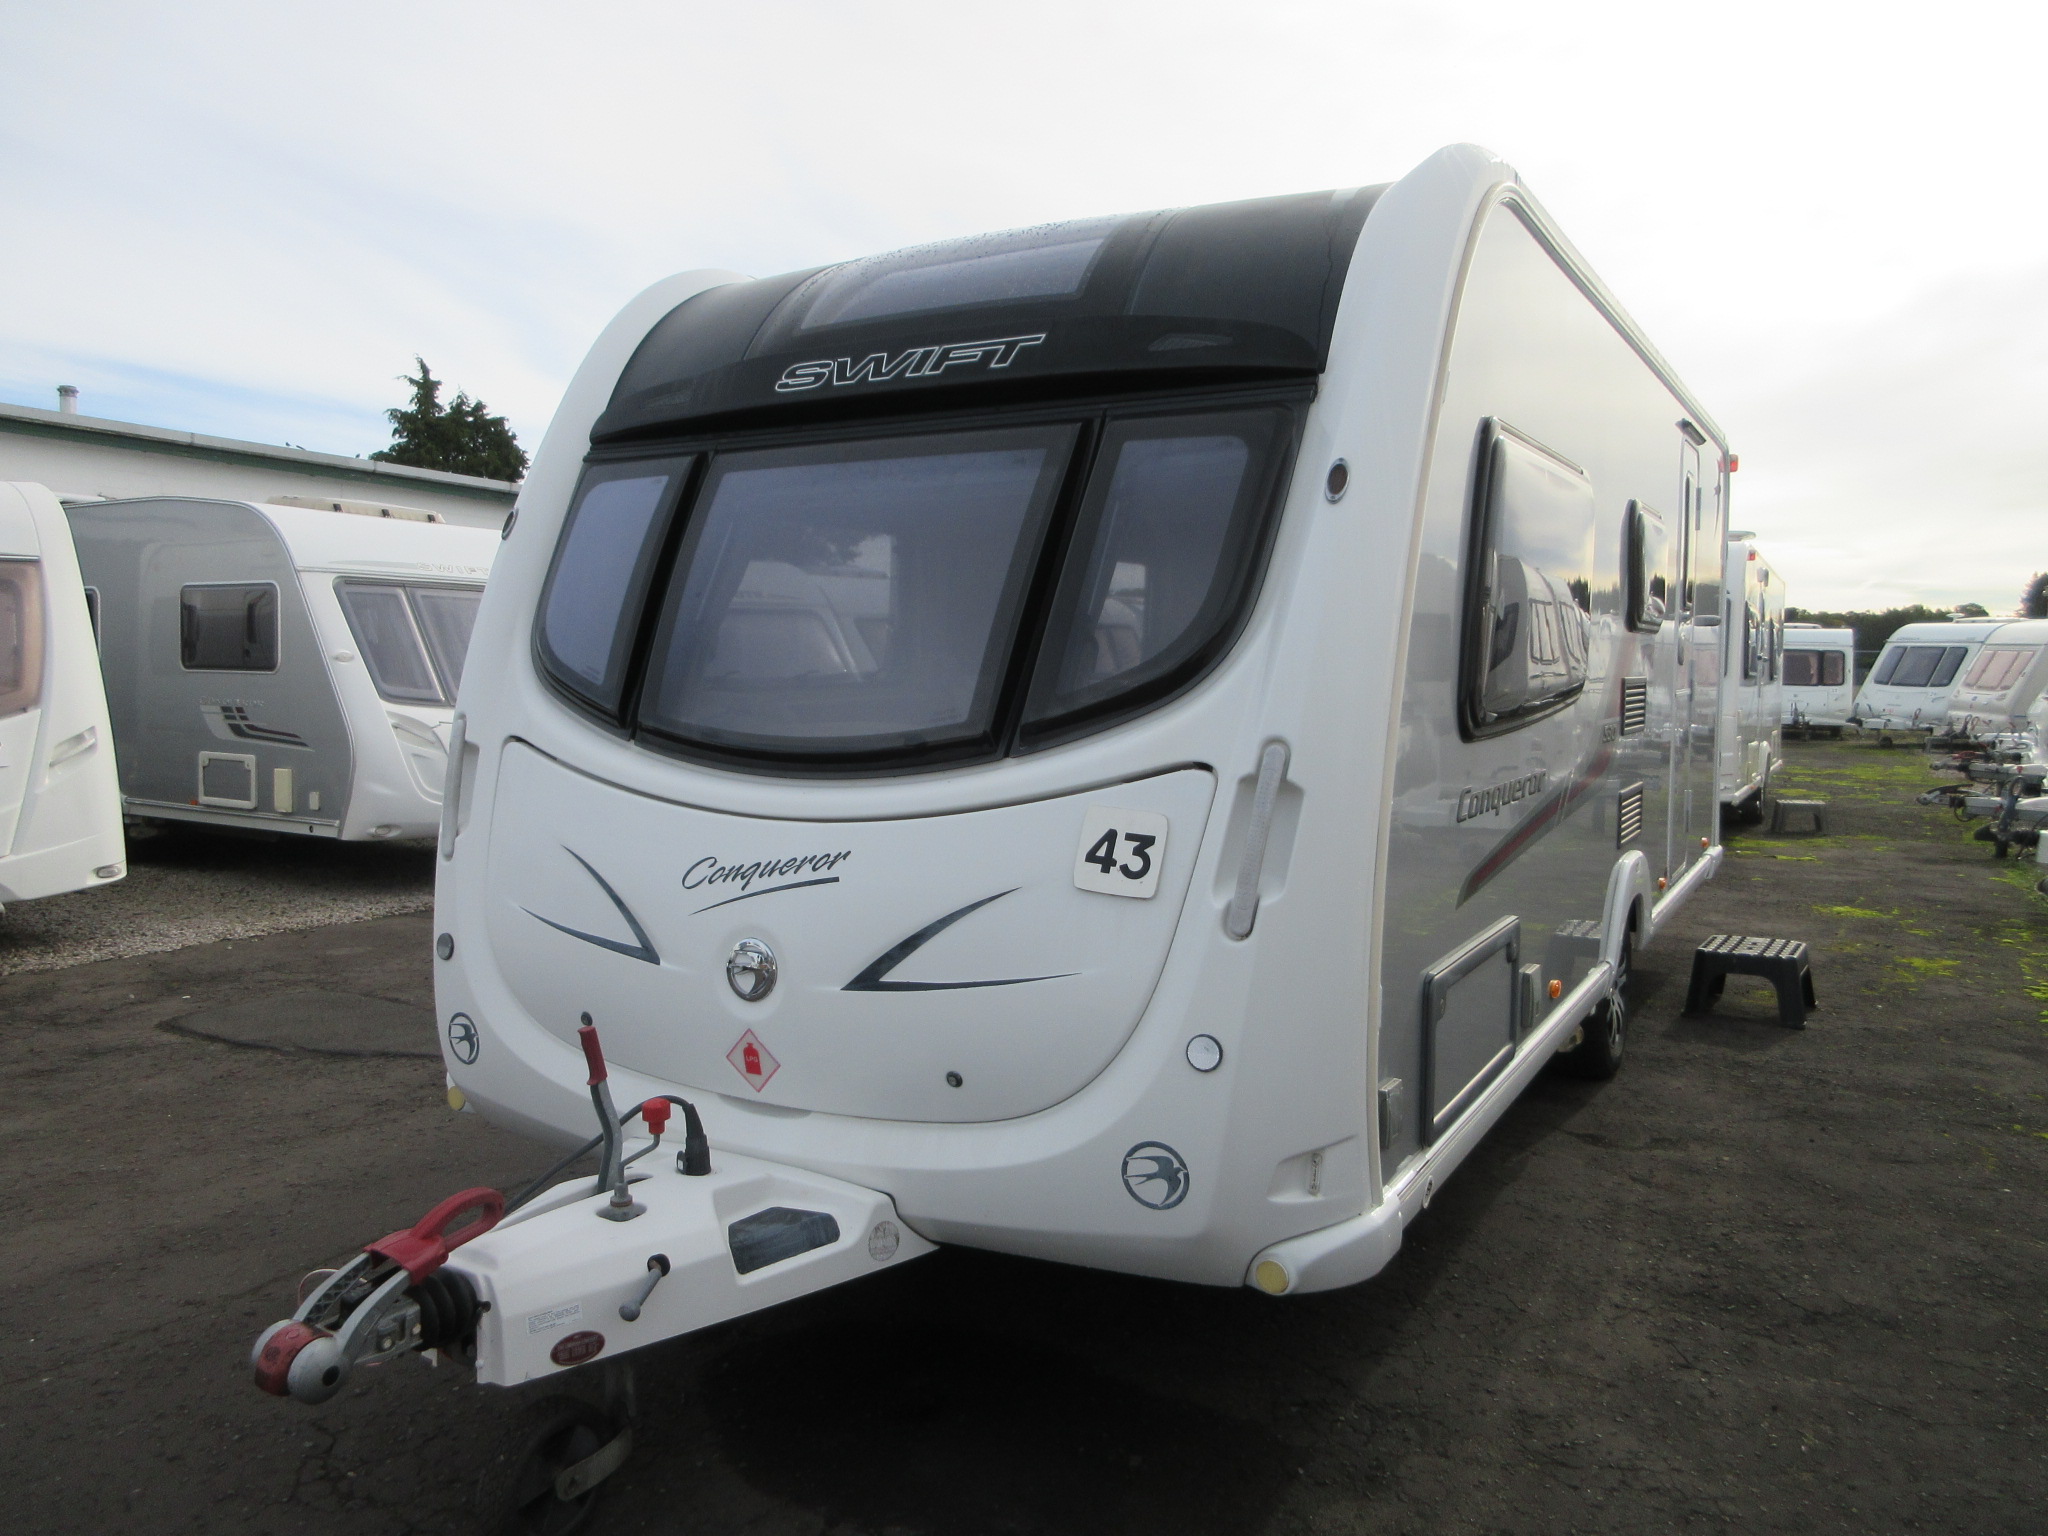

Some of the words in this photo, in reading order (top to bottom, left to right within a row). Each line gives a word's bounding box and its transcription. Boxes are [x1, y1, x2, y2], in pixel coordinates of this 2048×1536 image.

[775, 333, 1046, 392] SWIFT
[1457, 769, 1547, 823] Conqueror
[681, 850, 851, 891] Conqueror
[1084, 828, 1156, 880] 43
